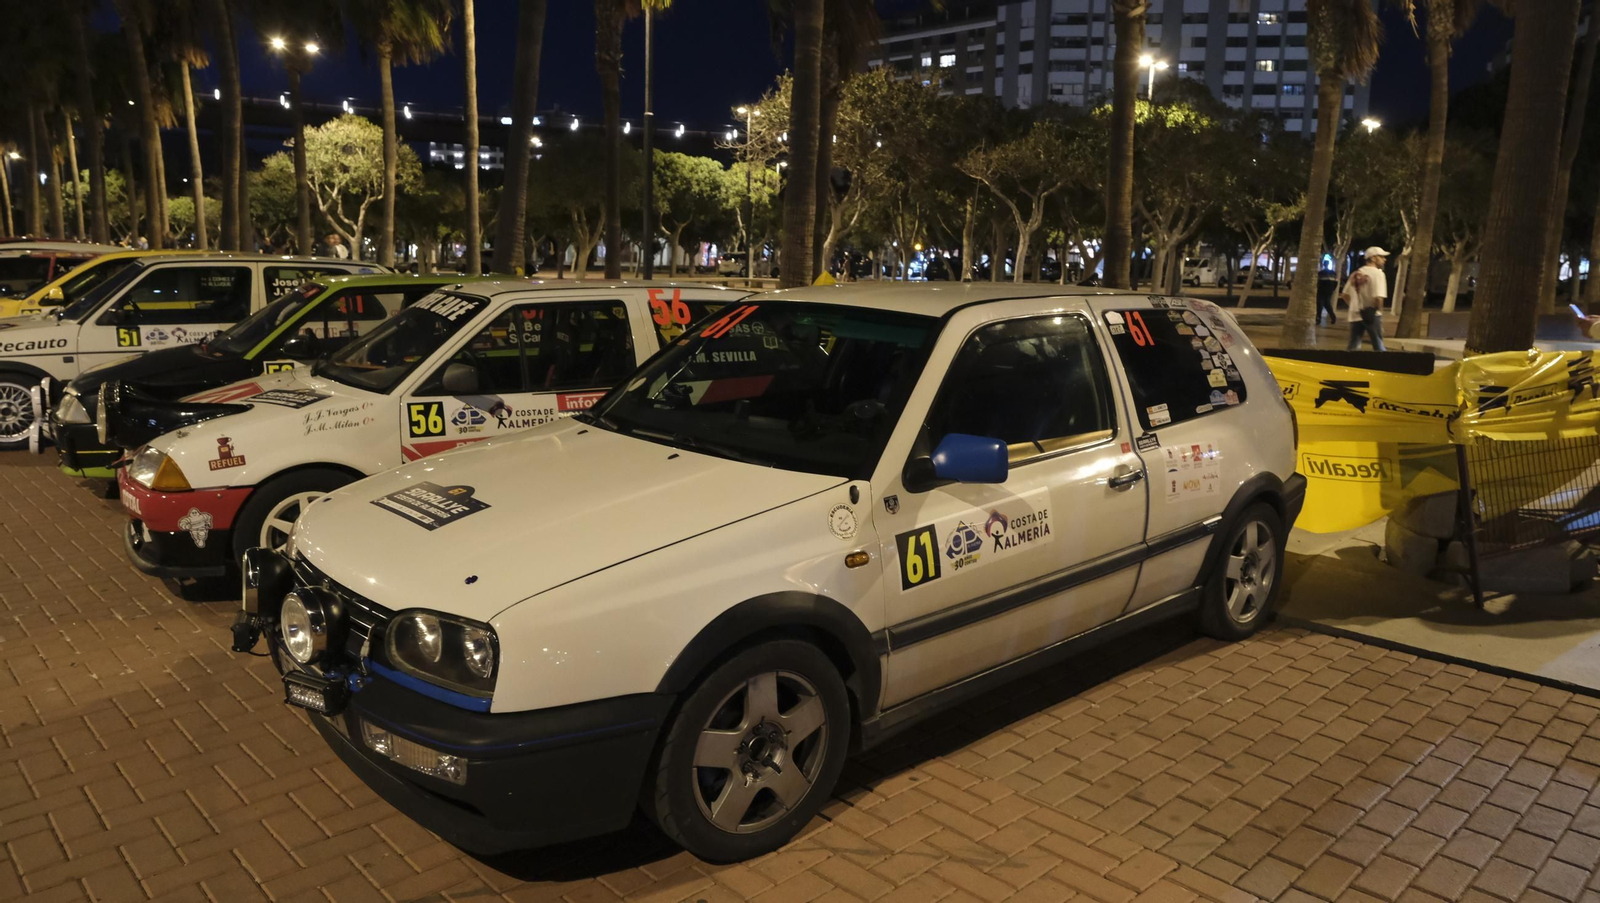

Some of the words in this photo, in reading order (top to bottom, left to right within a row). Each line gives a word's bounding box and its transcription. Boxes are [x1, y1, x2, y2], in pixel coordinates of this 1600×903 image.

[272, 278, 299, 287] Jose
[647, 288, 691, 326] 56
[700, 305, 760, 339] 61
[1125, 311, 1155, 346] 61
[119, 328, 138, 346] 51
[713, 351, 757, 362] SEVILLA
[326, 405, 360, 417] Vargas
[410, 404, 443, 435] 56
[210, 457, 244, 469] REFUEL
[416, 492, 470, 514] RALLYE
[1010, 513, 1037, 530] COSTA
[1038, 509, 1048, 521] DE
[1004, 519, 1051, 550] ALMERÍA
[906, 531, 935, 584] 61
[954, 557, 964, 571] 30
